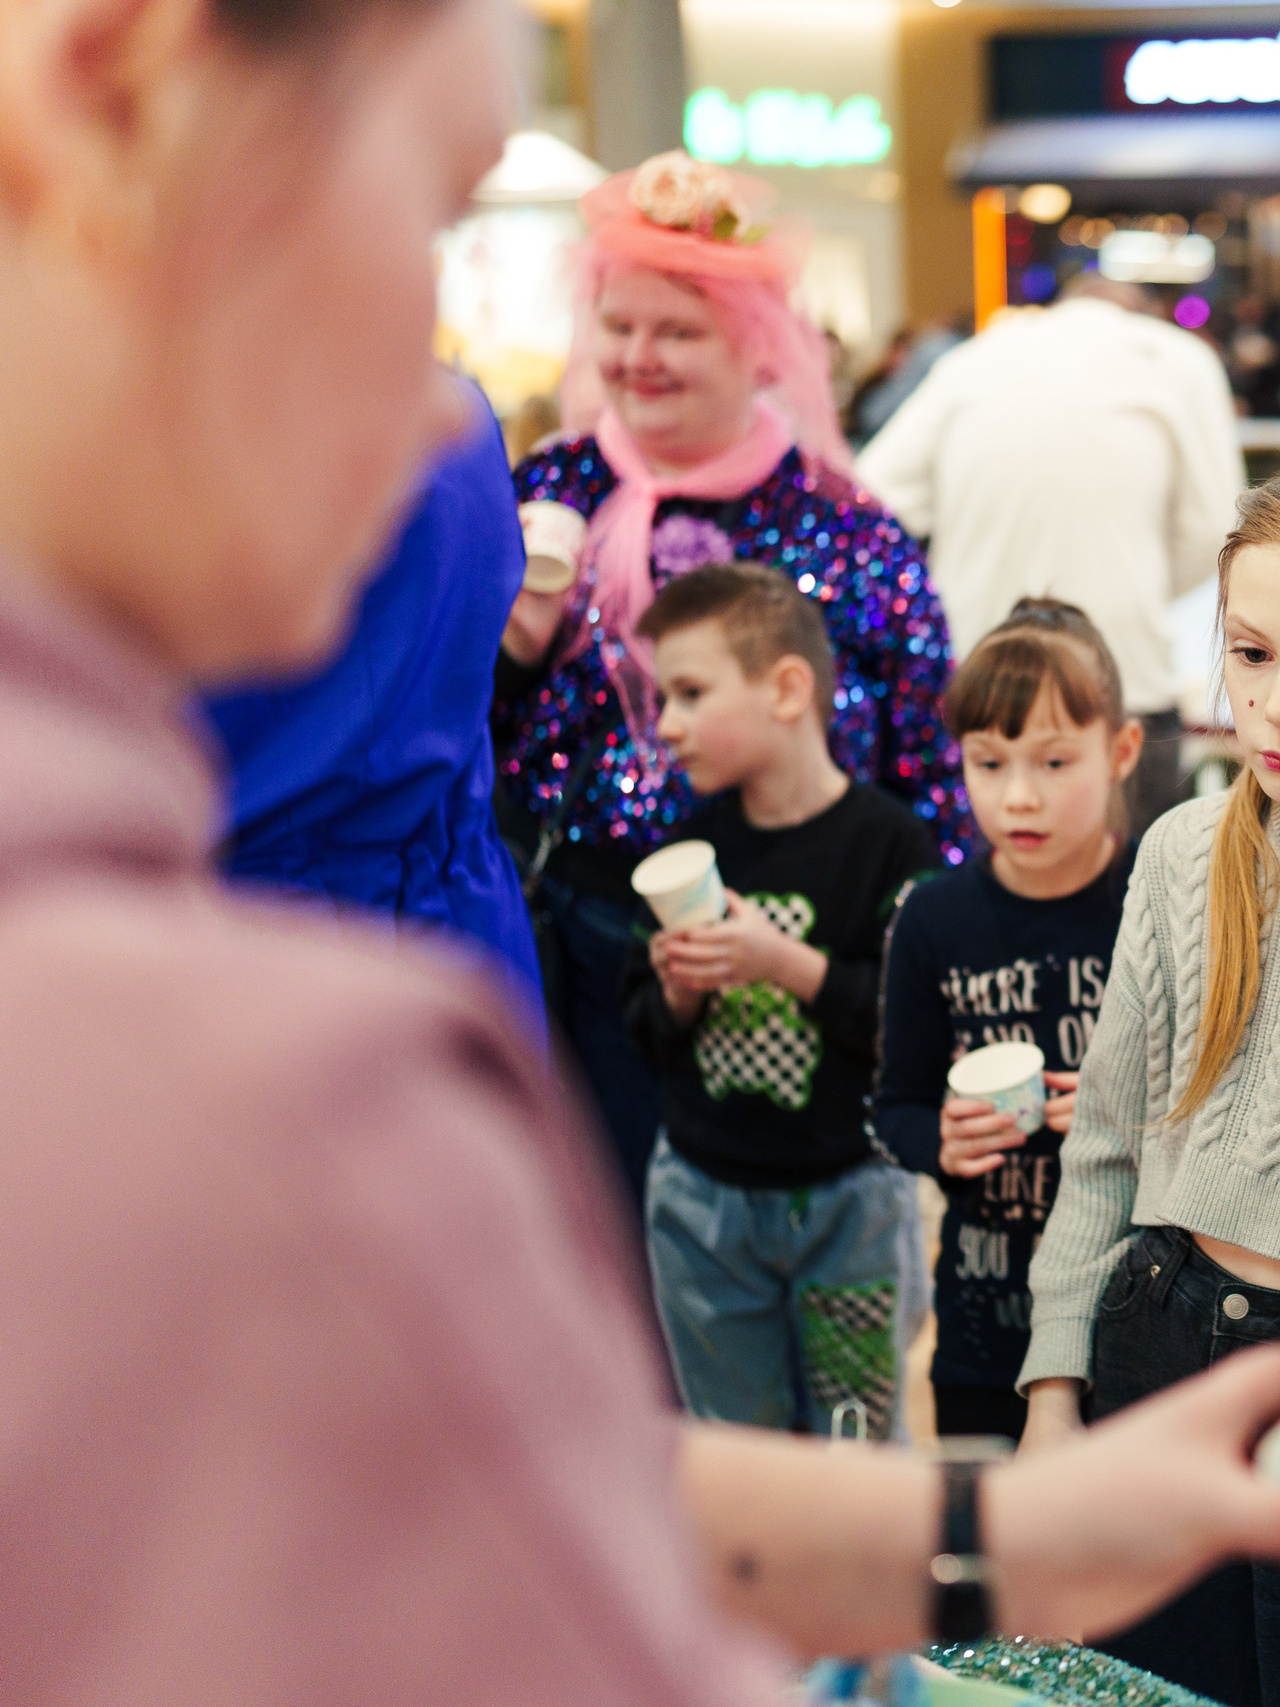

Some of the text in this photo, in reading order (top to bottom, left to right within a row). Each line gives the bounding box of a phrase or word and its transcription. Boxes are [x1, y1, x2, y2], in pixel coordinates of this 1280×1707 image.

[1068, 955, 1105, 1008] IS
[984, 1153, 1054, 1207] LIKE
[955, 1223, 1009, 1280] YOU
